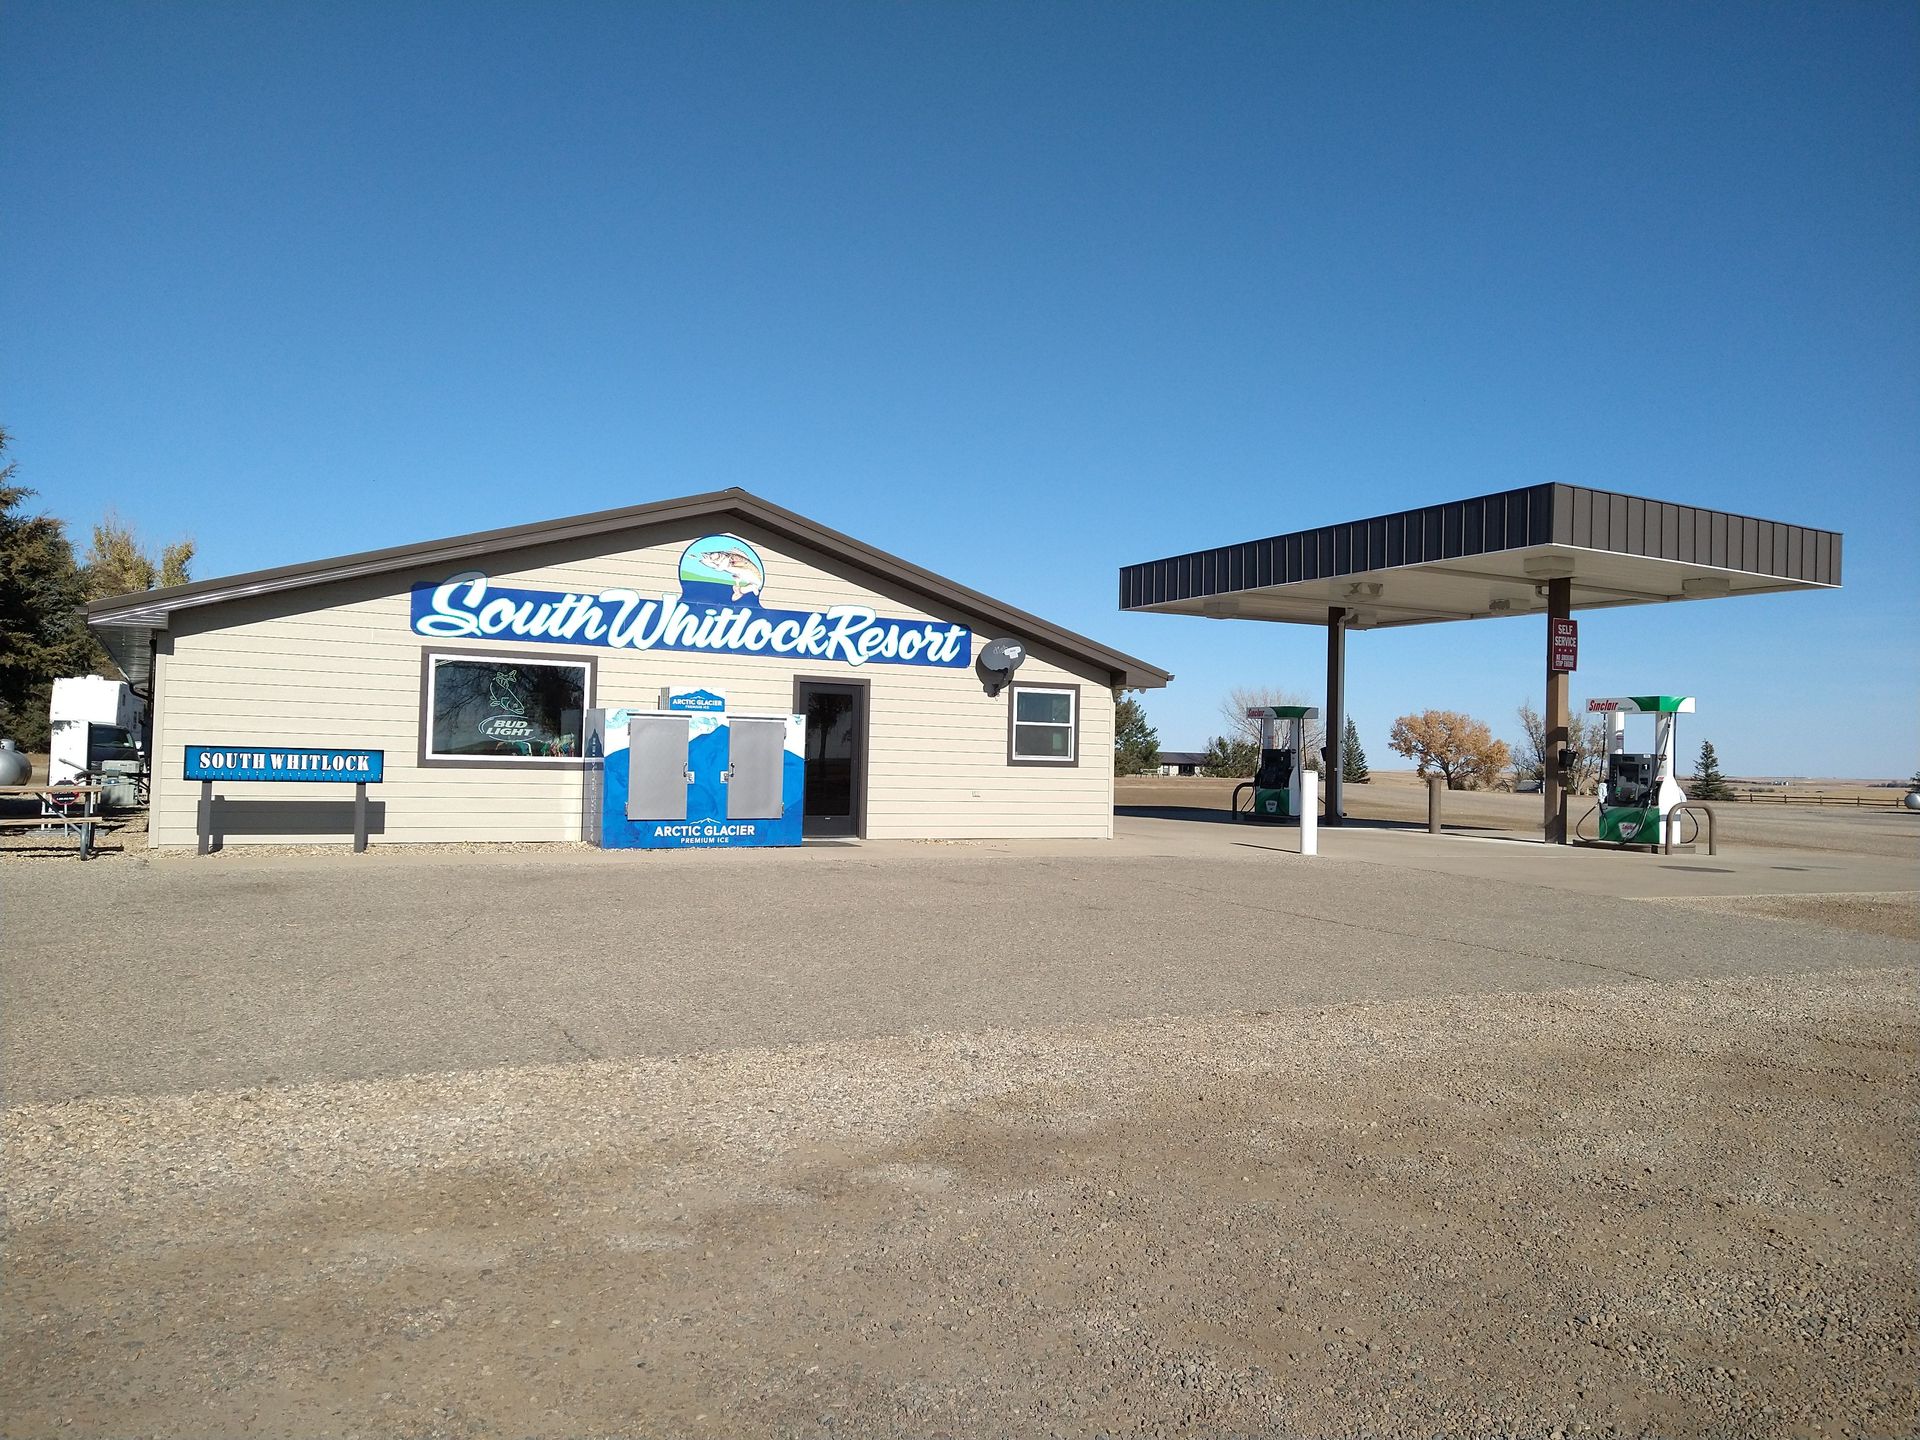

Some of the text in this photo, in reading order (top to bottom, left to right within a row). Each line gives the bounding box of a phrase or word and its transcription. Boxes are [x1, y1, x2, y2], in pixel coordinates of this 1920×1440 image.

[416, 571, 967, 667] South Whitlock Resort
[1558, 624, 1573, 634] SELF
[1555, 635, 1576, 647] SERVICE
[1589, 699, 1618, 711] Sinclair
[493, 720, 528, 728] BUD
[486, 727, 534, 736] LIGHT
[199, 752, 370, 771] SOUTH WHITLOCK
[654, 825, 755, 836] ARCTIC GLACIER
